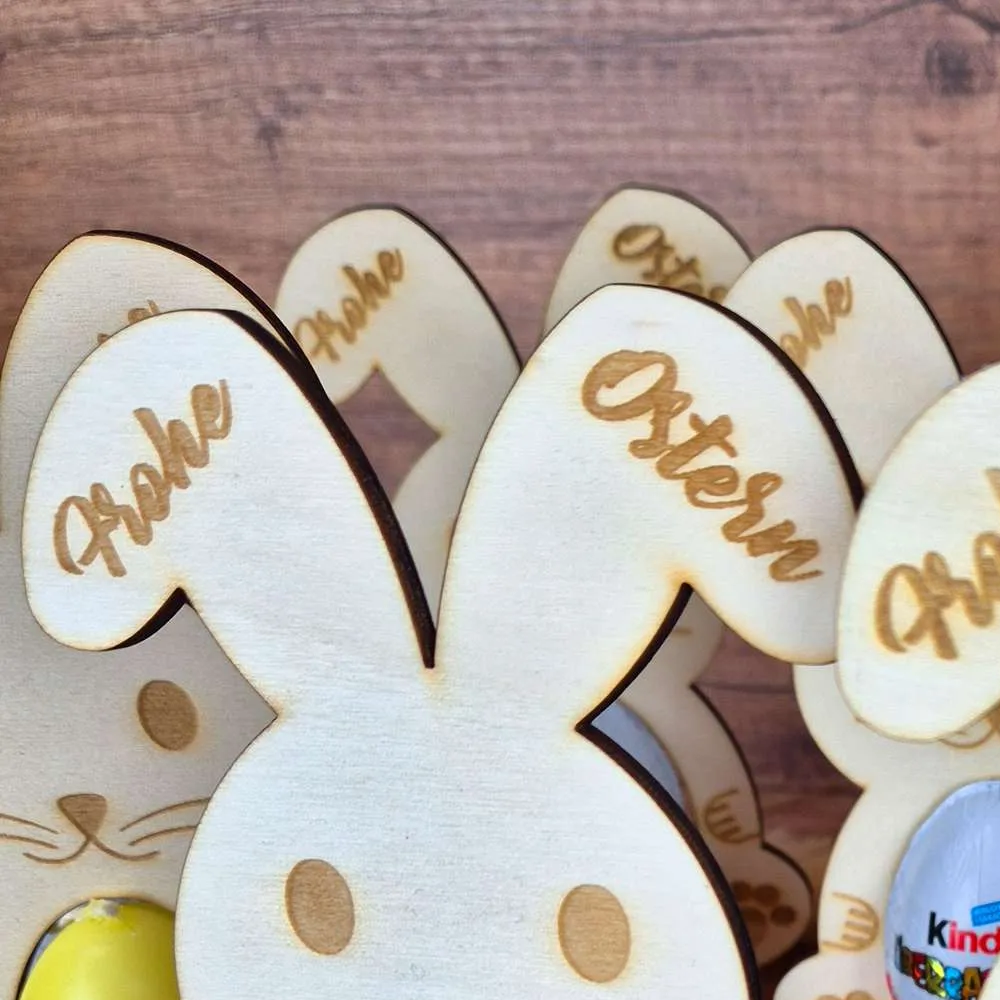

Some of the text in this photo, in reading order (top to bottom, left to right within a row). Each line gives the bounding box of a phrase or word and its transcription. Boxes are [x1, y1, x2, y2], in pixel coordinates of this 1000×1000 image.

[294, 248, 404, 363] Frohe
[613, 224, 728, 303] Ost
[780, 276, 853, 370] ohe
[53, 348, 823, 583] Frohe Ostern
